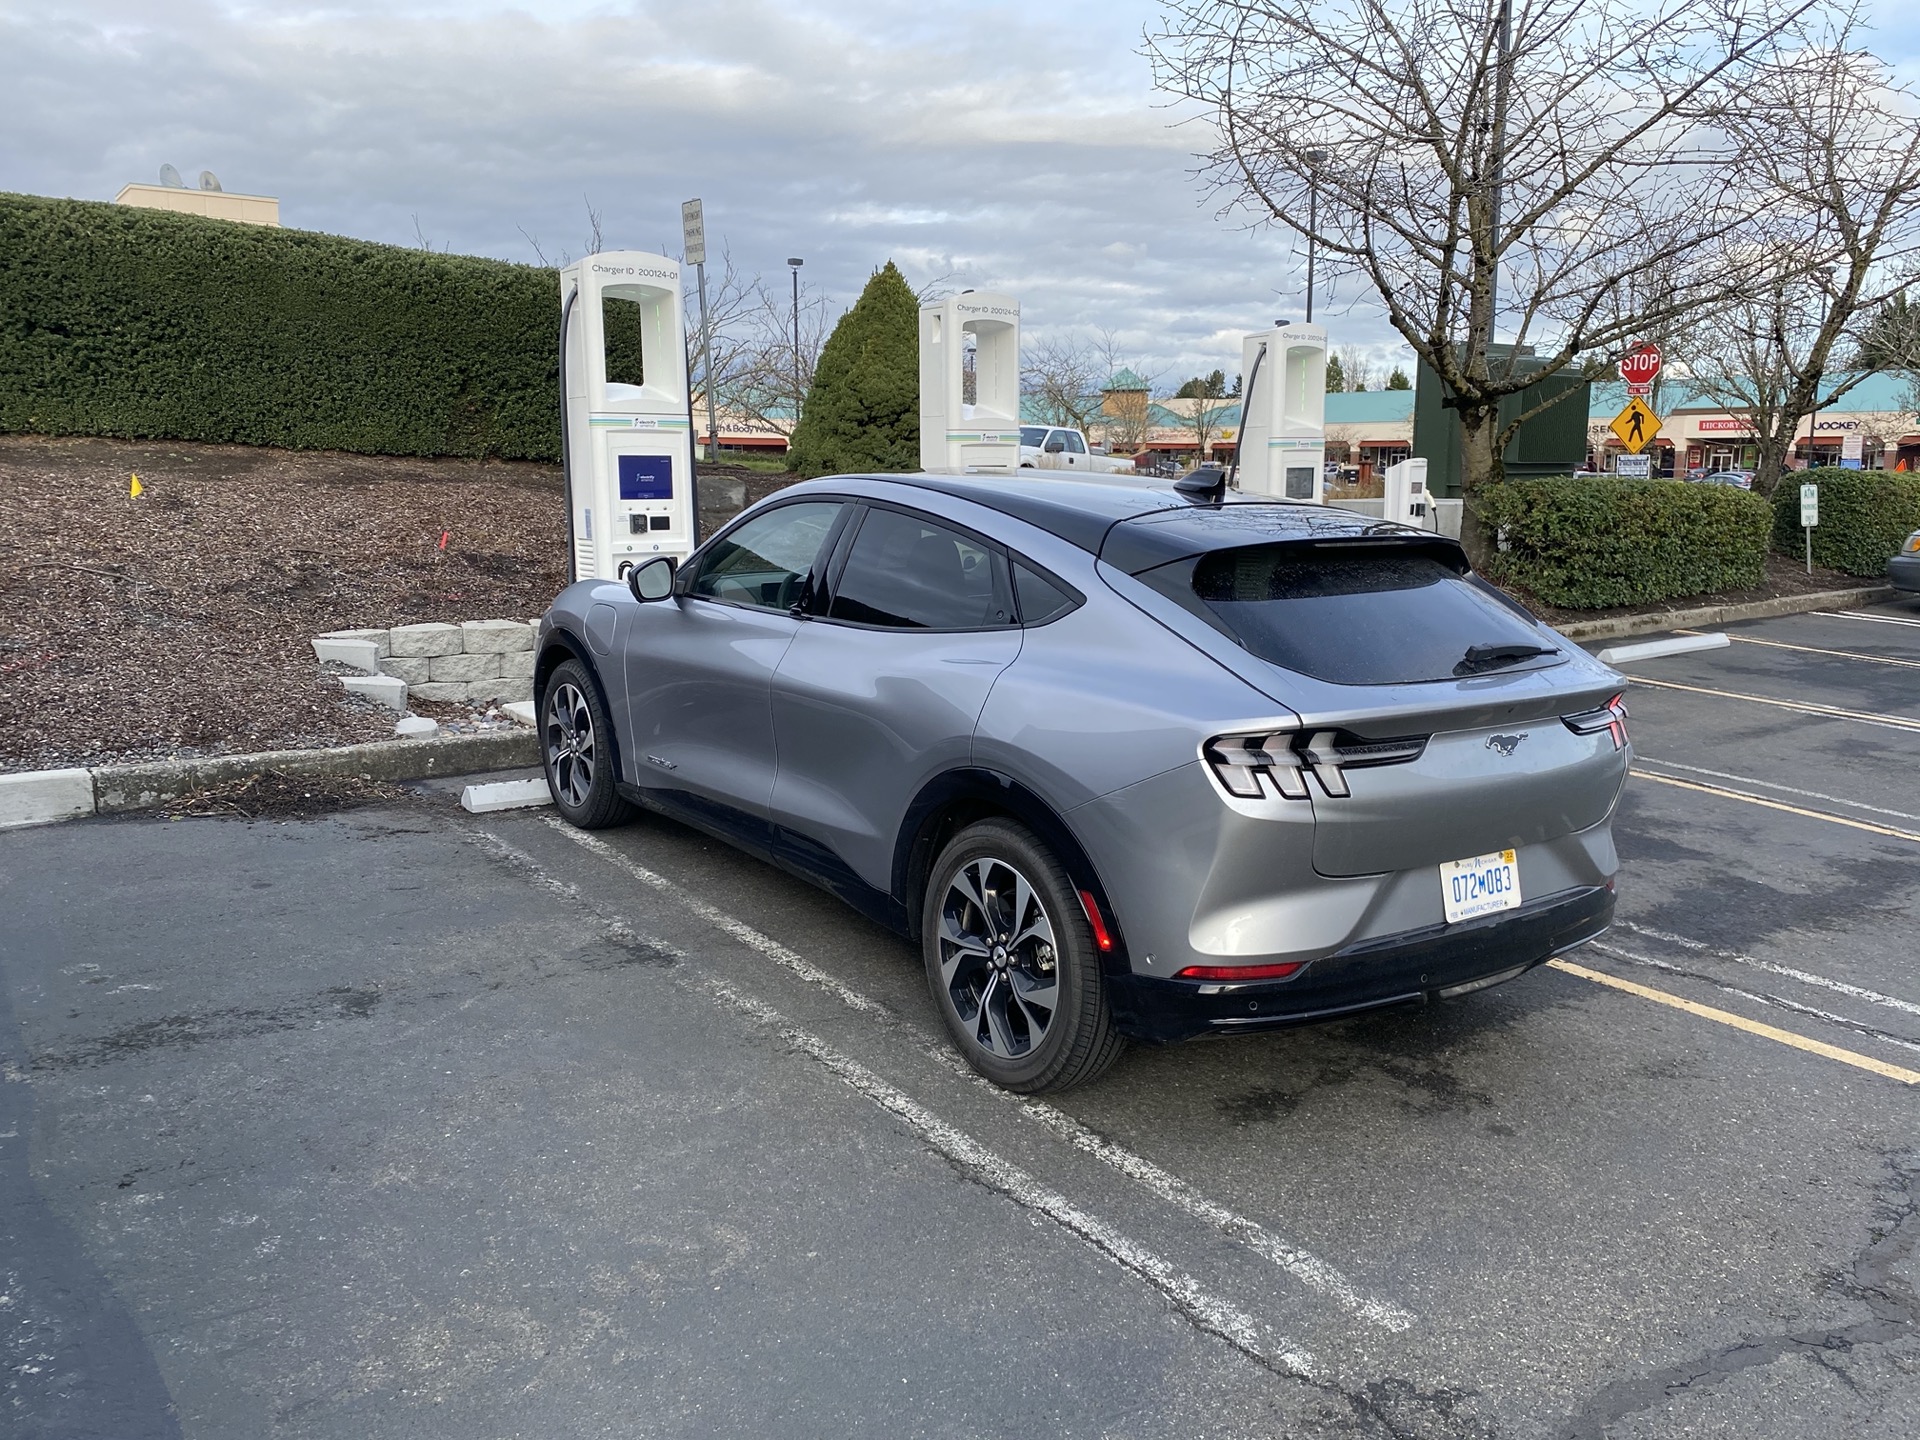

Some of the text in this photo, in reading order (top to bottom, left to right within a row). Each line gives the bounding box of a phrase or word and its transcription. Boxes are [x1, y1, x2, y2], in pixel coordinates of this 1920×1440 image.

[591, 264, 624, 275] Charger
[638, 268, 678, 280] 200124-01
[957, 304, 981, 313] Charger
[1623, 354, 1659, 371] STOP
[1702, 422, 1740, 430] HICKORY
[1814, 421, 1861, 430] JOCKEY
[1506, 851, 1514, 859] 22
[1452, 865, 1512, 903] 072M083
[1463, 899, 1504, 915] MANUFACTURER
